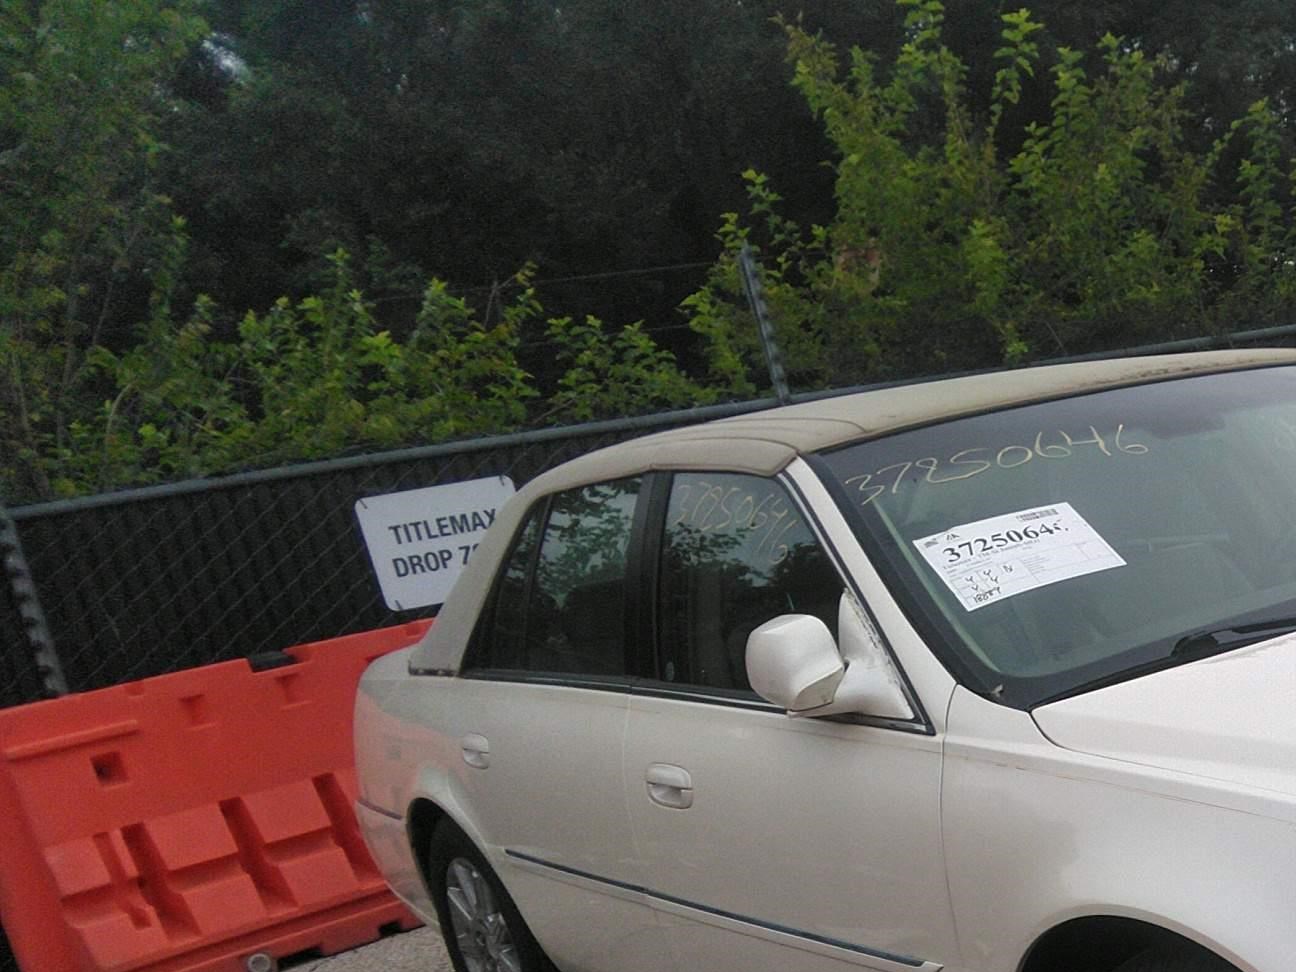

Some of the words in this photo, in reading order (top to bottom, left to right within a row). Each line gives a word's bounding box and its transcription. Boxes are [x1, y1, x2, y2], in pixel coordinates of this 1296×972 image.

[845, 424, 1149, 505] 37250646
[388, 508, 496, 545] TITLEMAX
[392, 549, 452, 577] DROP
